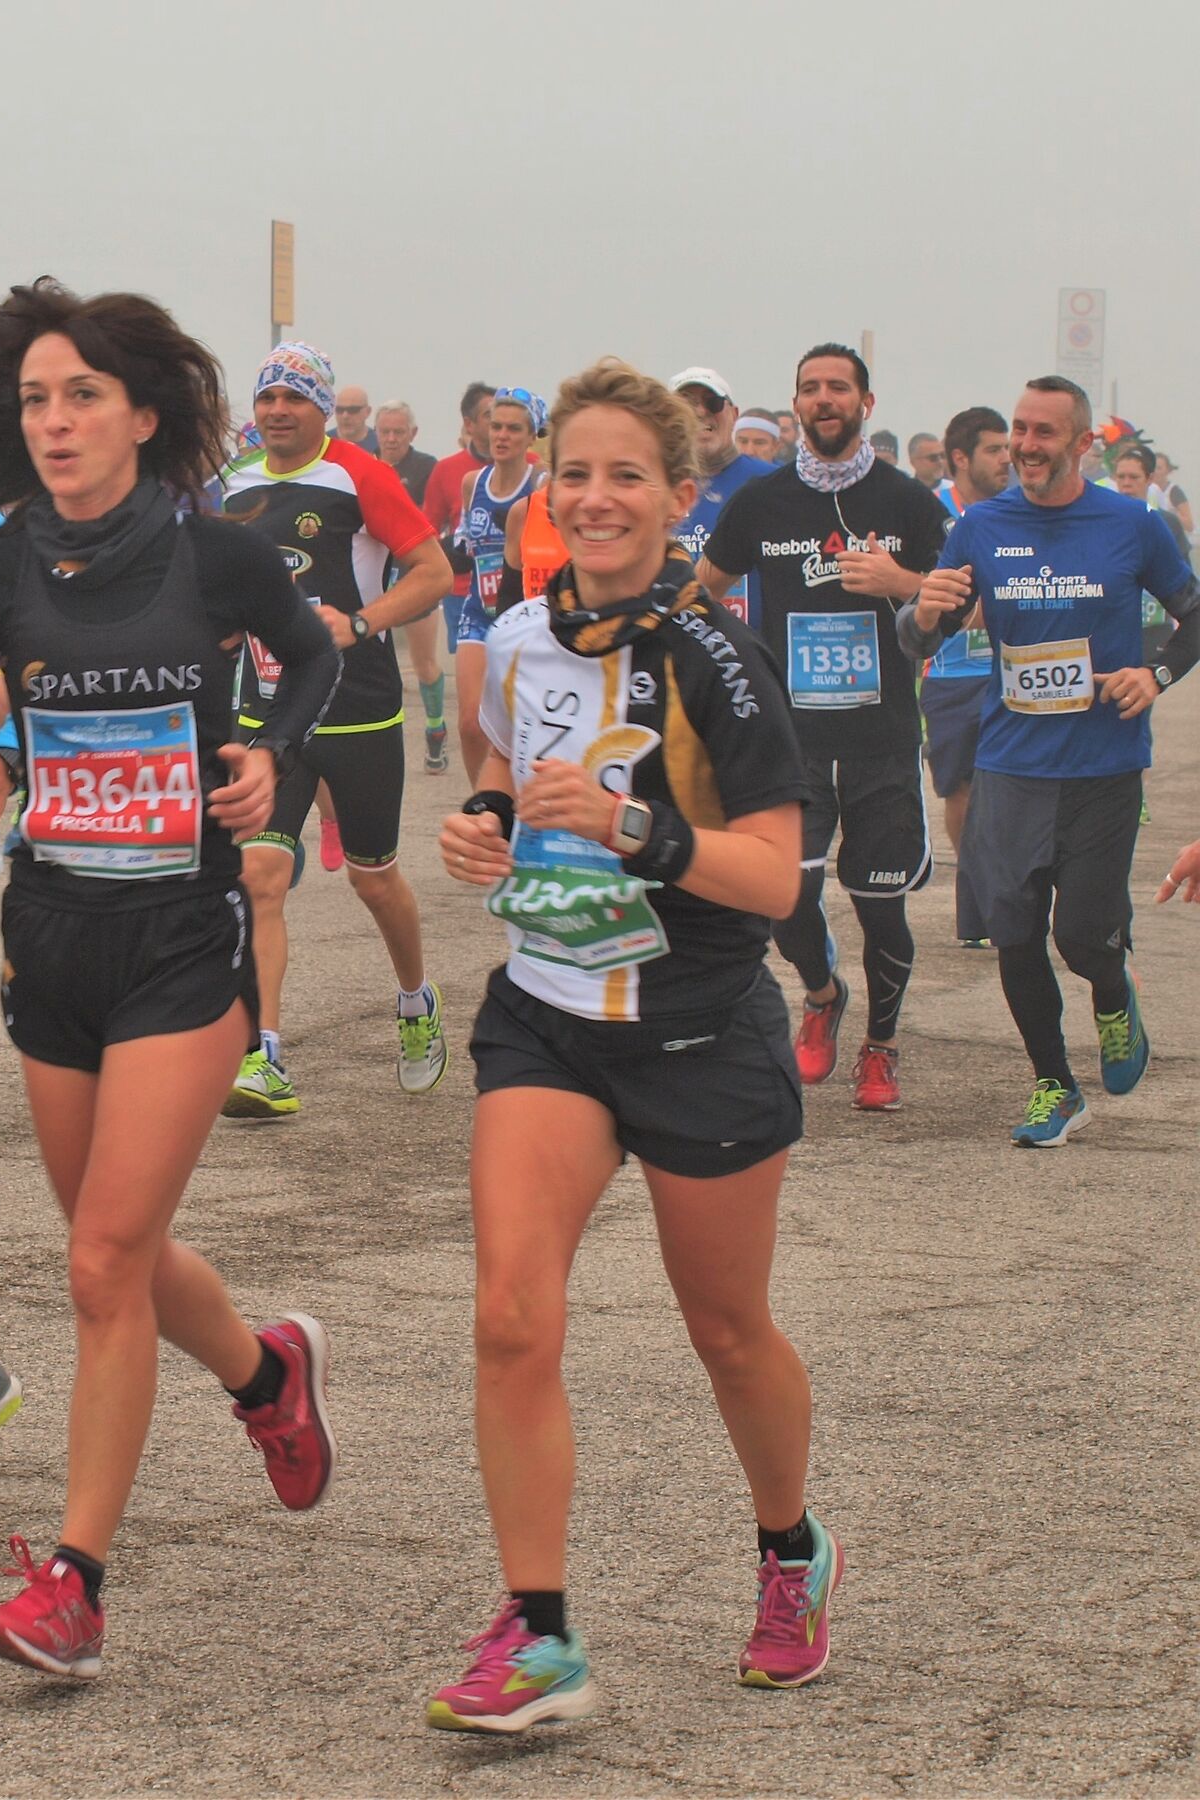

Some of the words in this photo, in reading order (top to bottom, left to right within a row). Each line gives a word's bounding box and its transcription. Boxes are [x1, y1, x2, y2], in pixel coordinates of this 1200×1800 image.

[761, 538, 821, 557] Reebok
[847, 535, 903, 553] CrosFit
[802, 553, 843, 580] Rave
[994, 585, 1044, 600] MARATONA
[1045, 584, 1056, 599] DI
[1057, 583, 1104, 598] RAVENNA
[1007, 577, 1050, 586] GLOBAL
[1052, 575, 1087, 585] PORTS
[672, 608, 760, 719] SPARTANS
[798, 645, 873, 673] 1338
[27, 663, 202, 702] SPARTANS
[811, 674, 841, 686] SILVIO
[1018, 664, 1084, 690] 6502
[1031, 688, 1073, 700] SAMUELE
[35, 763, 197, 816] H3644
[51, 815, 143, 834] PRISCILLA
